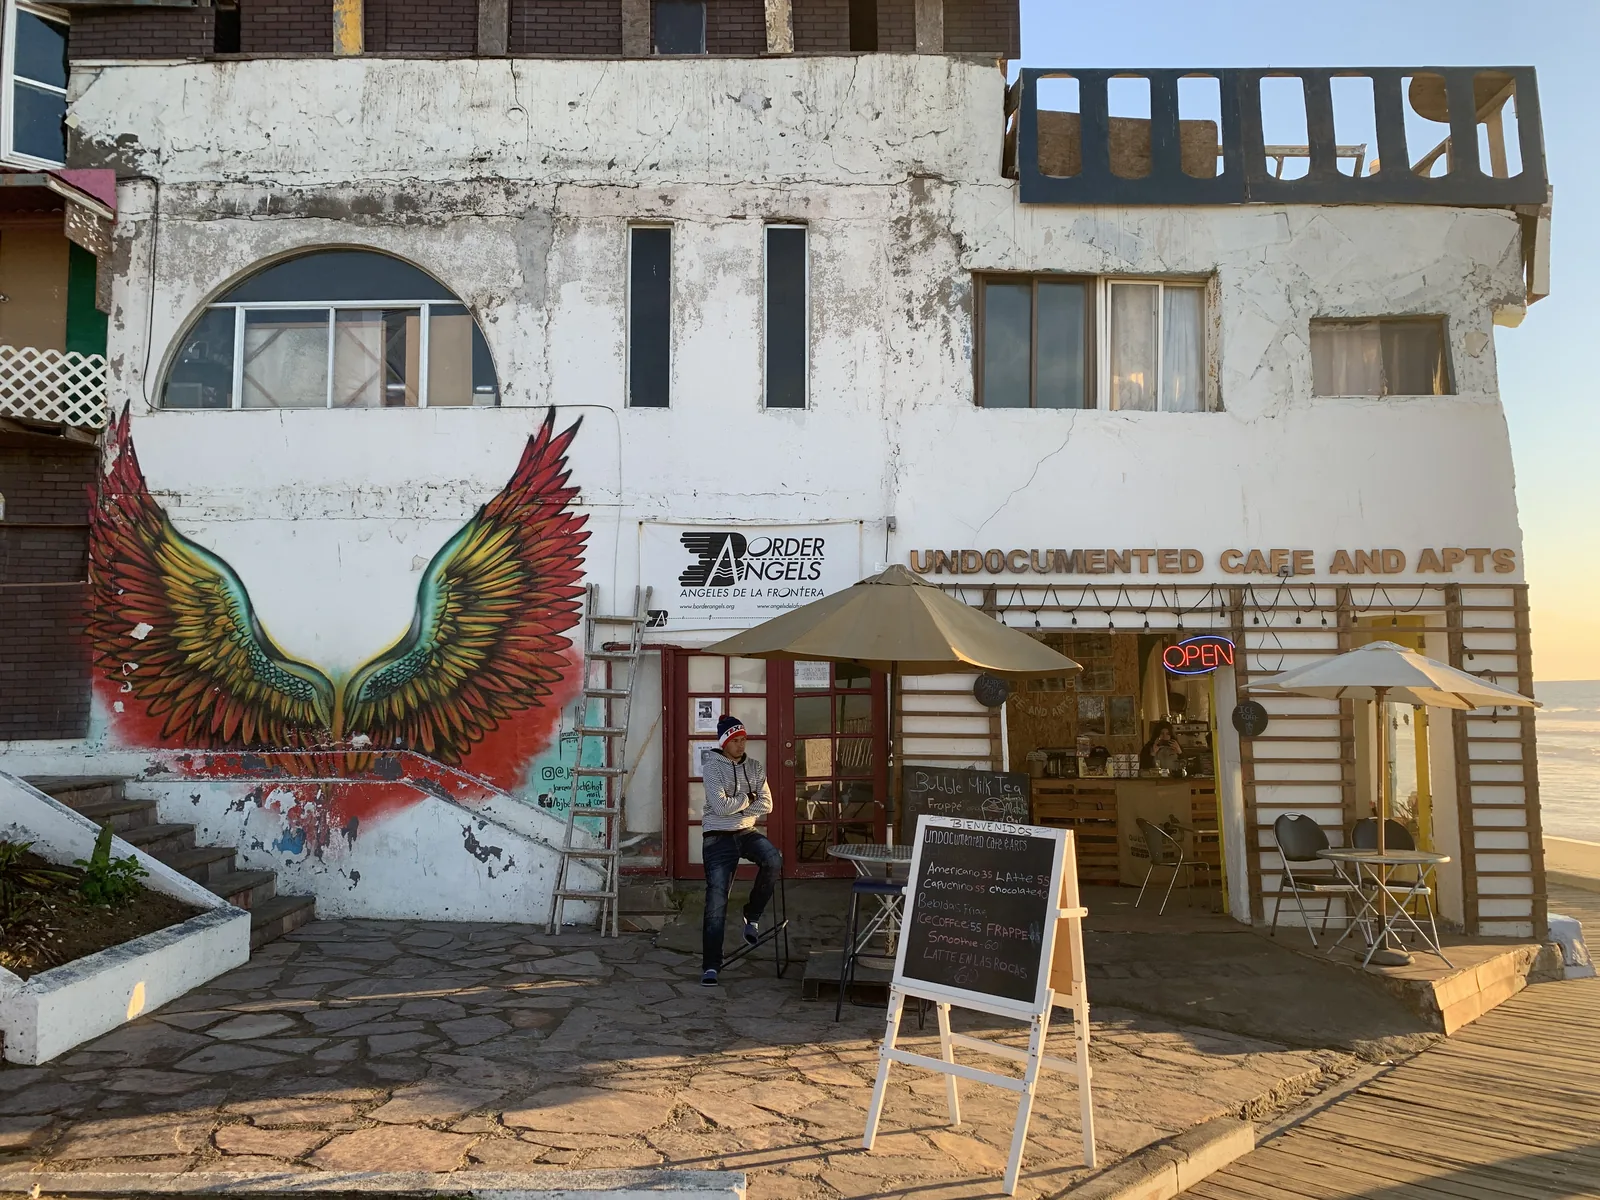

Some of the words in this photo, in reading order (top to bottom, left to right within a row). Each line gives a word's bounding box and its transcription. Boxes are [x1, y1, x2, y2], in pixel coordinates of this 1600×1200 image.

[910, 548, 1204, 574] UNDOCUMENTED
[1220, 548, 1316, 575] CAFE
[1329, 548, 1407, 574] AND
[1416, 547, 1516, 574] APTS
[680, 588, 729, 598] ANGELES
[733, 588, 746, 598] DE
[750, 588, 763, 598] LA
[767, 585, 825, 598] FRONTERA
[1163, 643, 1233, 668] OPEN
[911, 772, 963, 795] Bubble
[969, 776, 991, 795] Milk
[995, 776, 1021, 795] Tea
[950, 819, 1033, 836] BIENVENIDOS
[927, 861, 980, 879] Americano
[923, 947, 957, 963] LATTE
